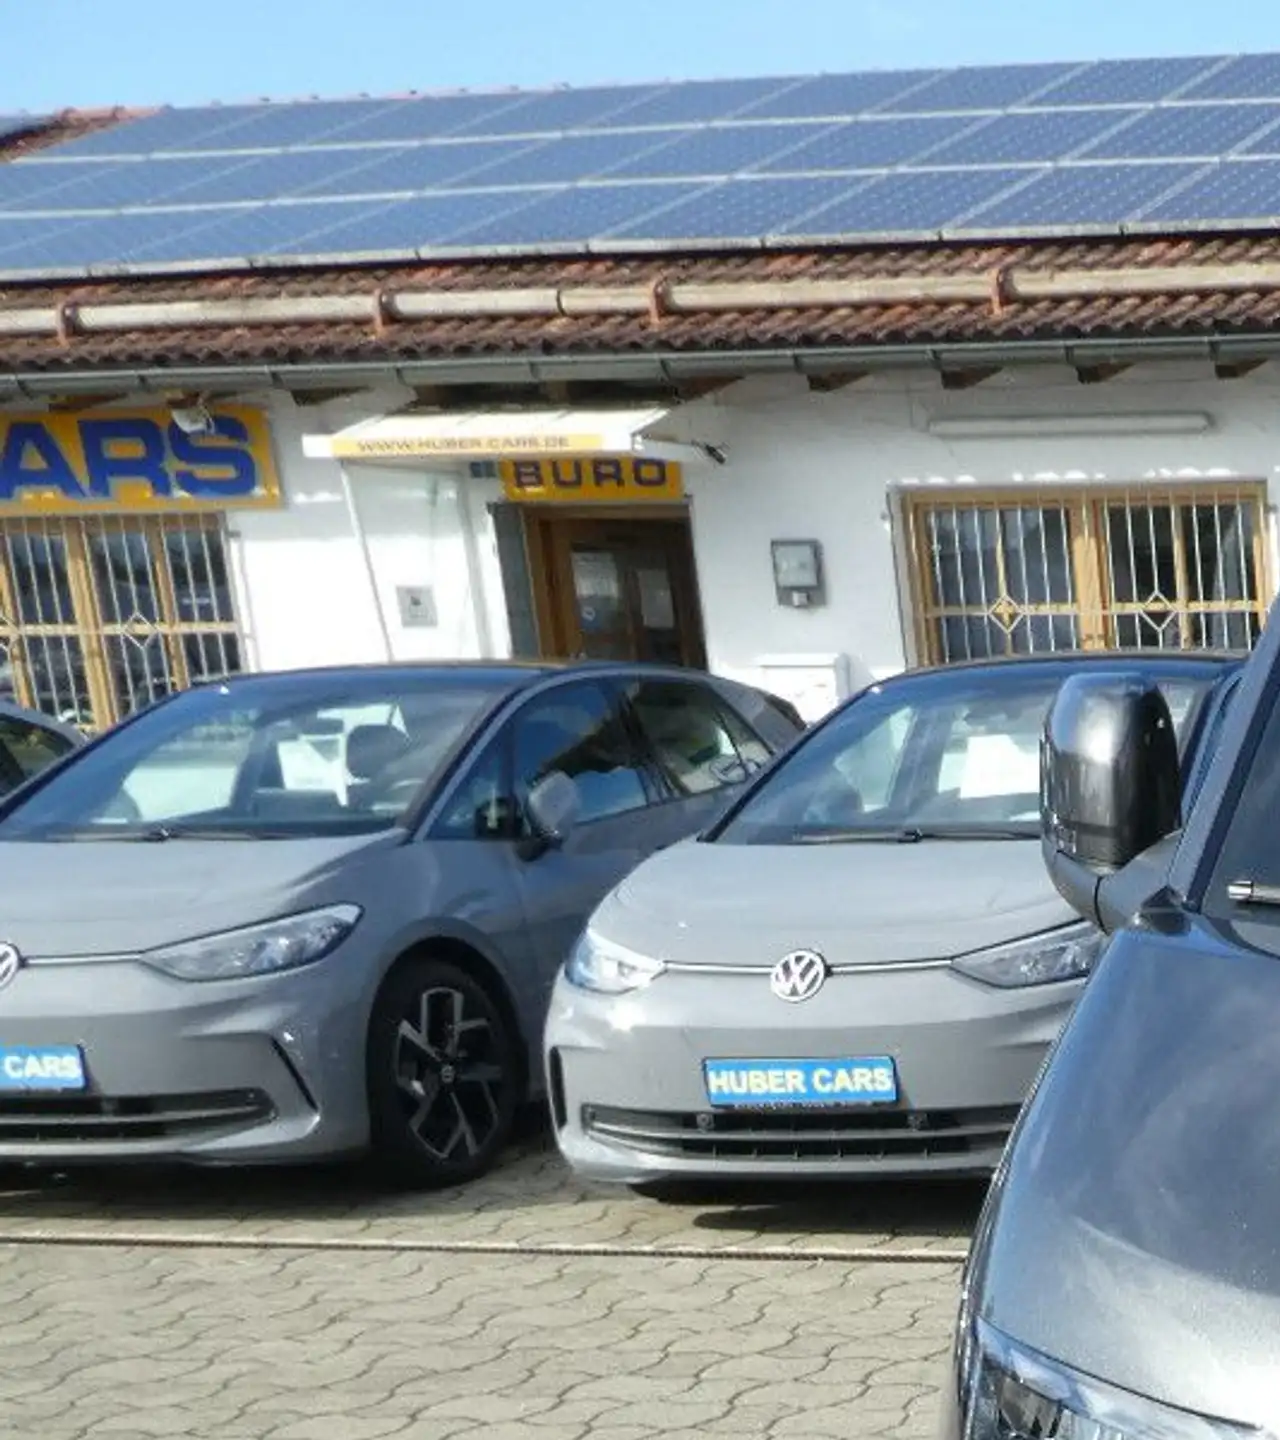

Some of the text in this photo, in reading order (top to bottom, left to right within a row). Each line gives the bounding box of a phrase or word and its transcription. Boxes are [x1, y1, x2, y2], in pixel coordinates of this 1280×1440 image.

[0, 415, 256, 498] ARS
[4, 1054, 82, 1078] CARS
[708, 1067, 892, 1095] HUBER CARS
